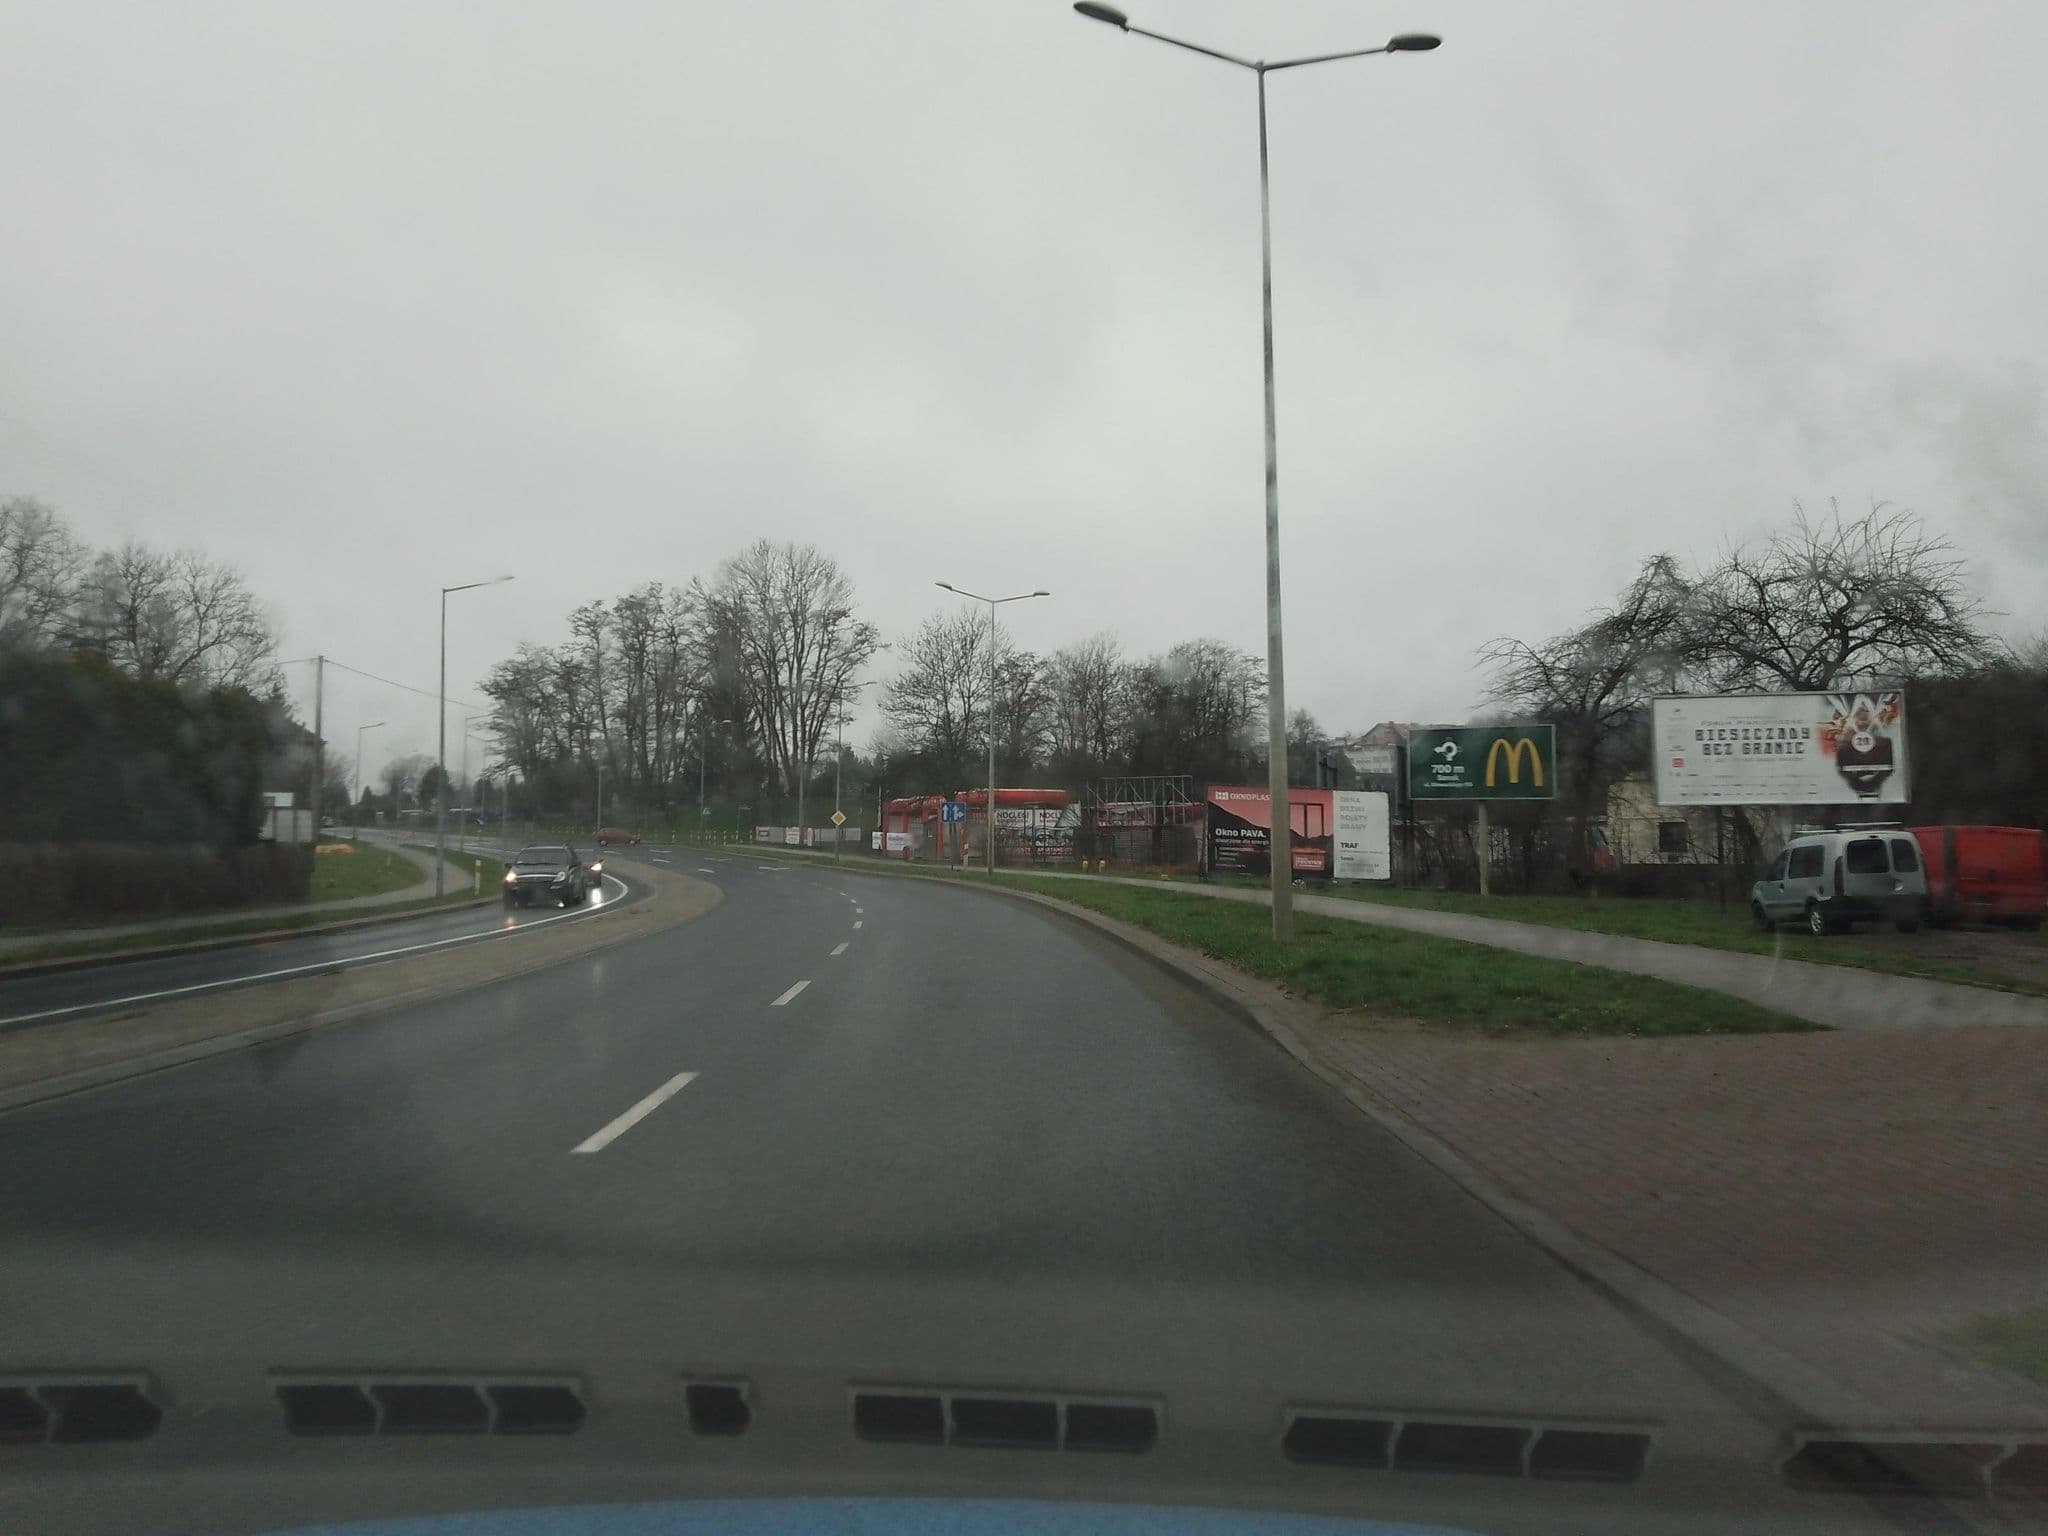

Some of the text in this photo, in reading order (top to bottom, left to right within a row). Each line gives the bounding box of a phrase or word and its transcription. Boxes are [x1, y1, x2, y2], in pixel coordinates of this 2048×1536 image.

[1695, 728, 1811, 741] BIESZCZADY
[1702, 742, 1805, 755] BEZ GRANIC
[1431, 764, 1452, 773] 700
[1230, 792, 1272, 801] OKNOPLAS
[1215, 828, 1239, 836] Okno
